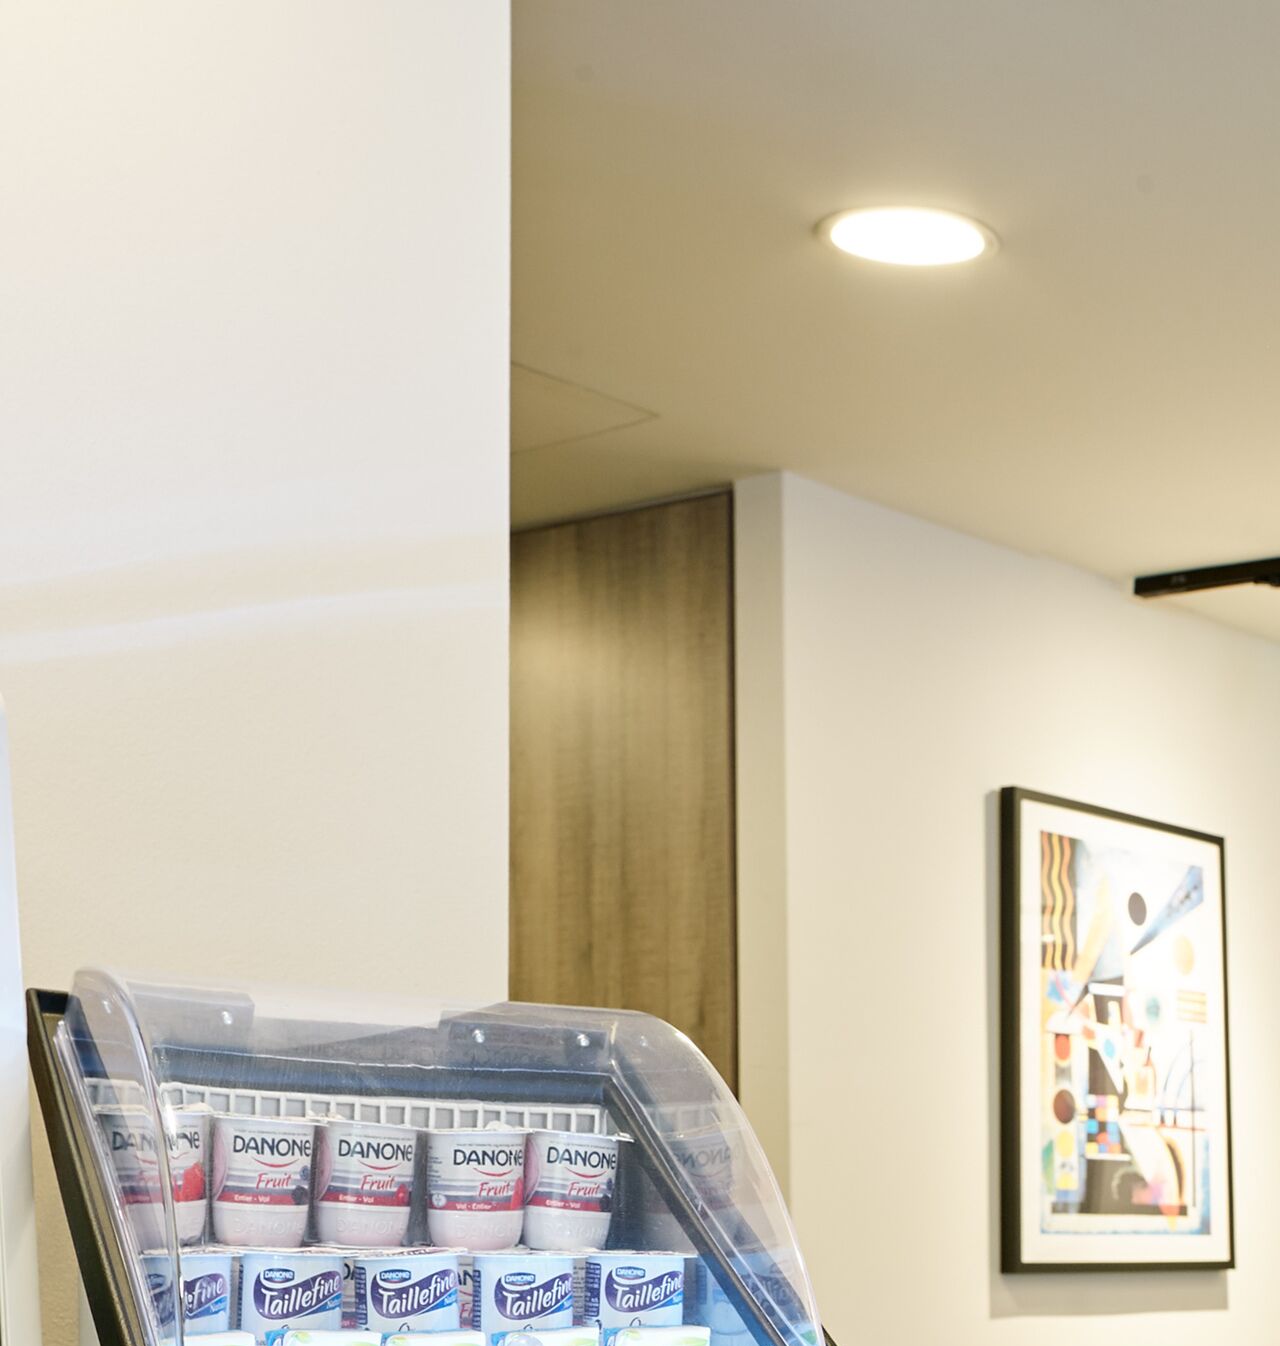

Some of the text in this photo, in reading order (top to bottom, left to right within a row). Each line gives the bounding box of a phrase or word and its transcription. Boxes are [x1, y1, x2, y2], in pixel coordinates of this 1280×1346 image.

[233, 1134, 312, 1158] DANONE
[338, 1138, 413, 1162] DANONE
[453, 1148, 523, 1167] DANONE
[546, 1146, 617, 1170] DANONE
[255, 1172, 292, 1190] Fruit
[361, 1174, 396, 1191] Fruit
[479, 1180, 511, 1197] Fruit
[567, 1181, 601, 1197] Fruit
[259, 1275, 340, 1317] Taillefine
[378, 1272, 455, 1316] Taillefine
[502, 1276, 572, 1317] Taillefine
[613, 1272, 682, 1314] Taillefine
